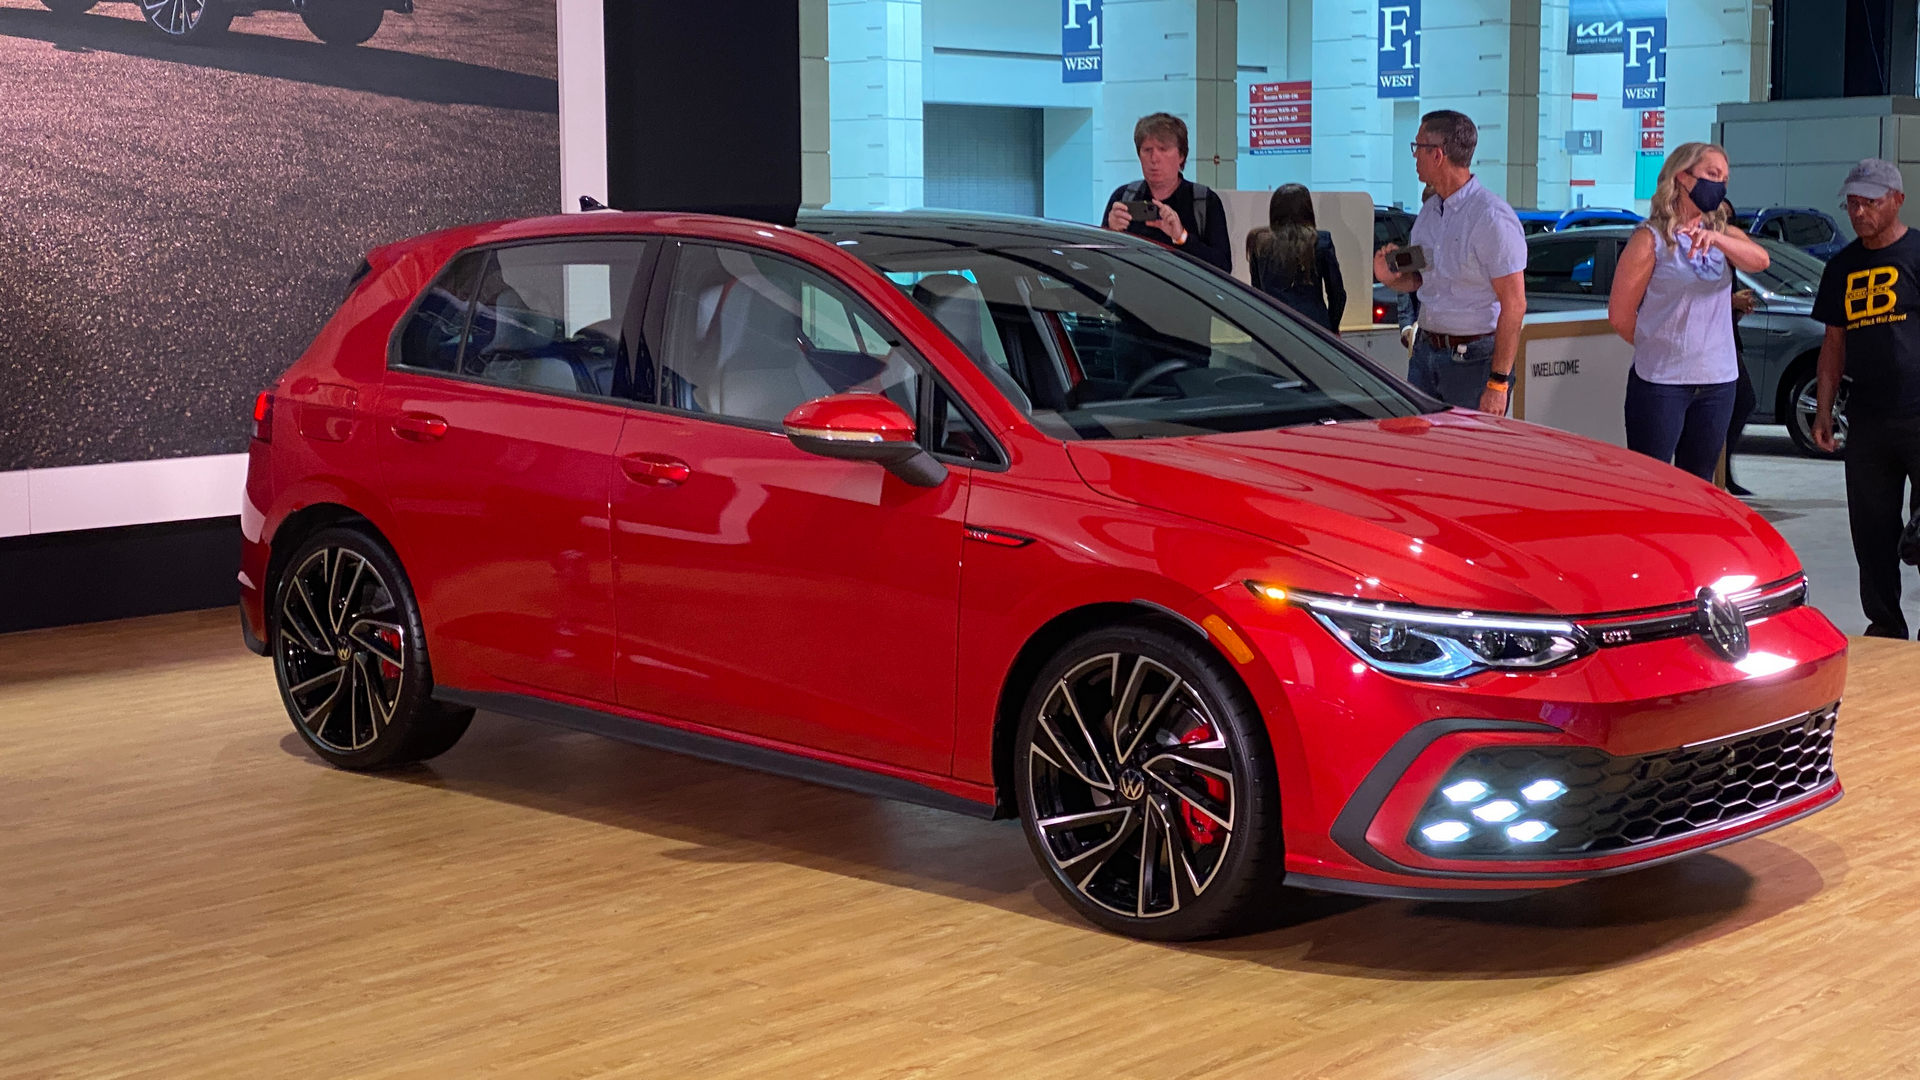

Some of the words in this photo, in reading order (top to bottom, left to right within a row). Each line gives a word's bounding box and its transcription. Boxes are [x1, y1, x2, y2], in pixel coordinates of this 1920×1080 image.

[1380, 5, 1415, 70] F1
[1626, 26, 1658, 83] F1
[1064, 56, 1101, 71] WEST
[1380, 74, 1414, 88] WEST
[1625, 87, 1658, 100] WEST
[1888, 313, 1907, 322] Street
[1532, 358, 1580, 377] WELCOME
